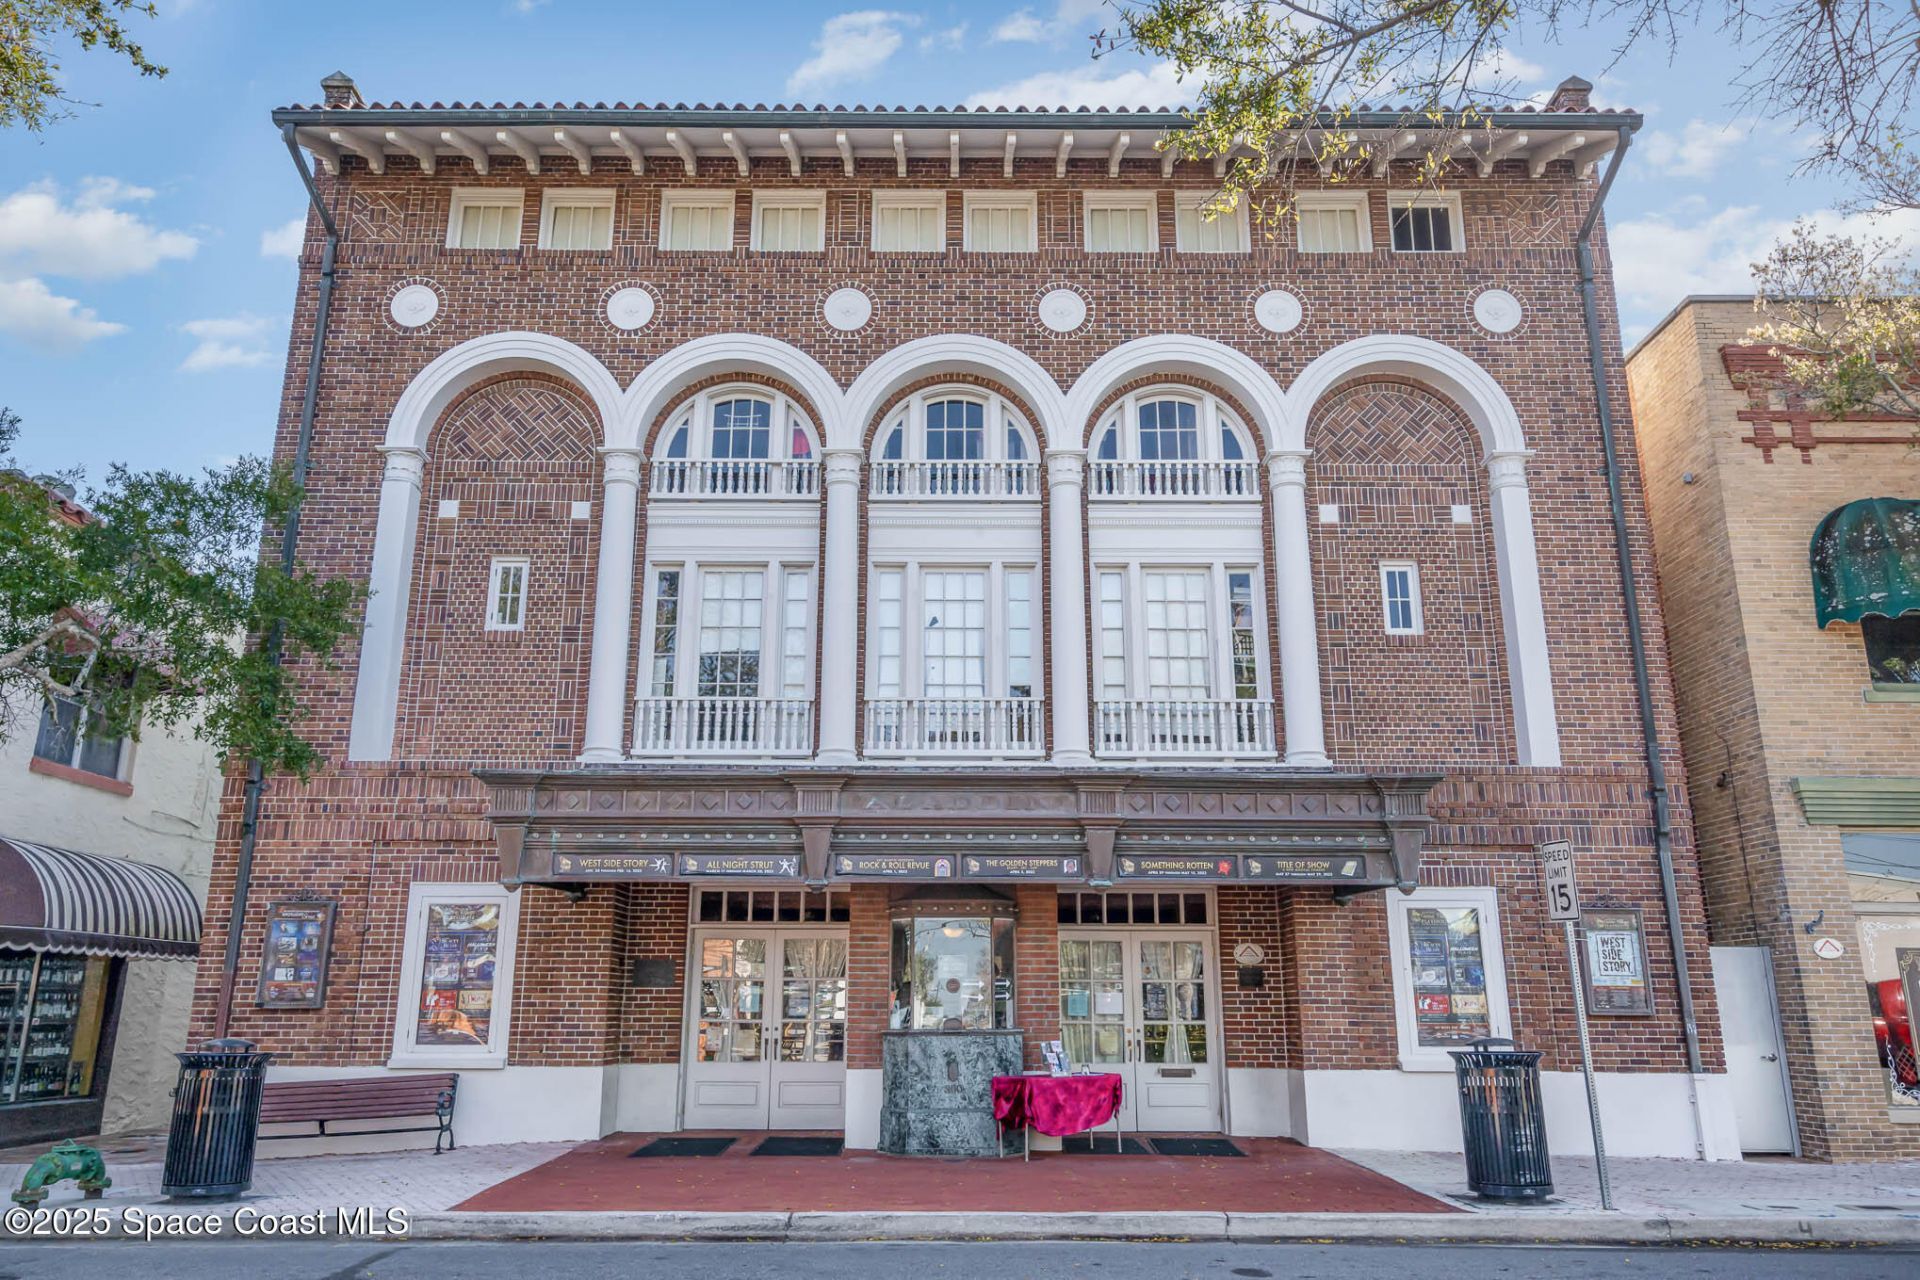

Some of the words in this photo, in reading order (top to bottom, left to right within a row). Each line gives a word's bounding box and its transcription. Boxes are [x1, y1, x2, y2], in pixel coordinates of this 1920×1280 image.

[1544, 849, 1569, 861] SPEED
[580, 859, 601, 867] WEST
[603, 859, 621, 867] SIDE
[623, 859, 649, 867] STORY
[706, 861, 720, 869] ALL
[722, 861, 748, 869] NIGHT
[750, 861, 774, 869] STRUT
[859, 861, 880, 869] ROCK
[881, 861, 887, 869] &
[888, 861, 906, 869] ROLL
[907, 861, 930, 869] REVUE
[985, 859, 998, 867] THE
[999, 859, 1028, 867] GOLDEN
[1029, 859, 1058, 867] STEPPERS
[1141, 861, 1185, 869] SOMETHING
[1186, 861, 1214, 870] ROTTEN
[1277, 861, 1294, 869] TITLE
[1295, 861, 1305, 869] OF
[1307, 861, 1330, 869] SHOW
[1548, 866, 1568, 880] LIMIT
[1550, 884, 1572, 913] 15
[1600, 936, 1626, 948] WEST
[1601, 948, 1623, 961] SIDE
[1602, 960, 1631, 972] STORY
